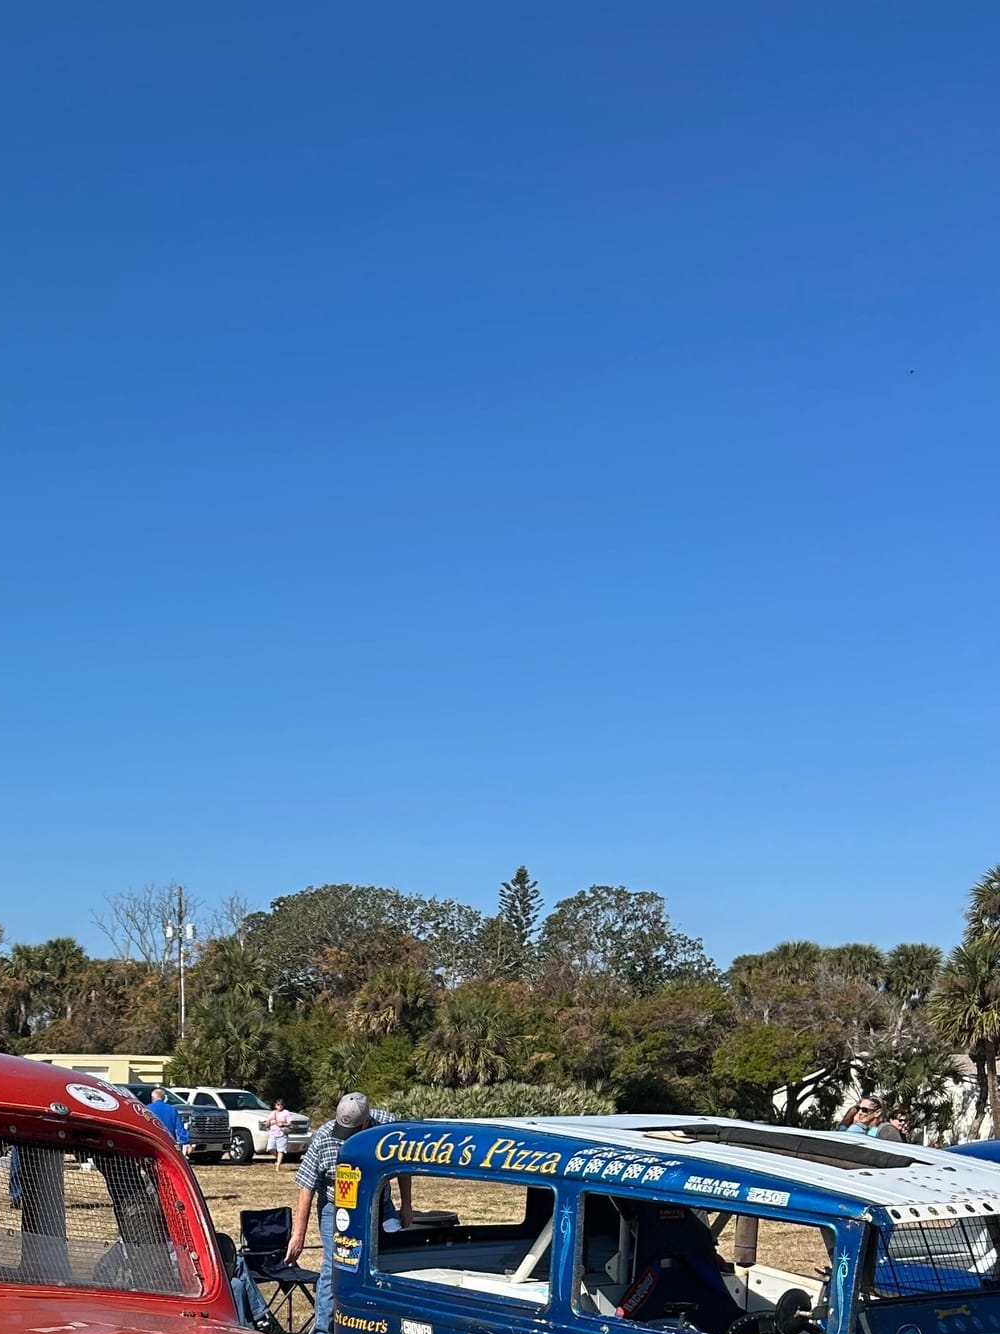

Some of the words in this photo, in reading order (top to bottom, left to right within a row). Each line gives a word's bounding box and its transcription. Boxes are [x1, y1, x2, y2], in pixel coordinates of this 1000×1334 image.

[375, 1130, 477, 1167] Guida's
[480, 1137, 562, 1175] Pizza
[683, 1181, 713, 1194] MAKES
[713, 1185, 724, 1195] IT
[687, 1175, 703, 1184] SIX
[720, 1180, 741, 1190] ROW
[334, 1309, 388, 1334] Steamer's
